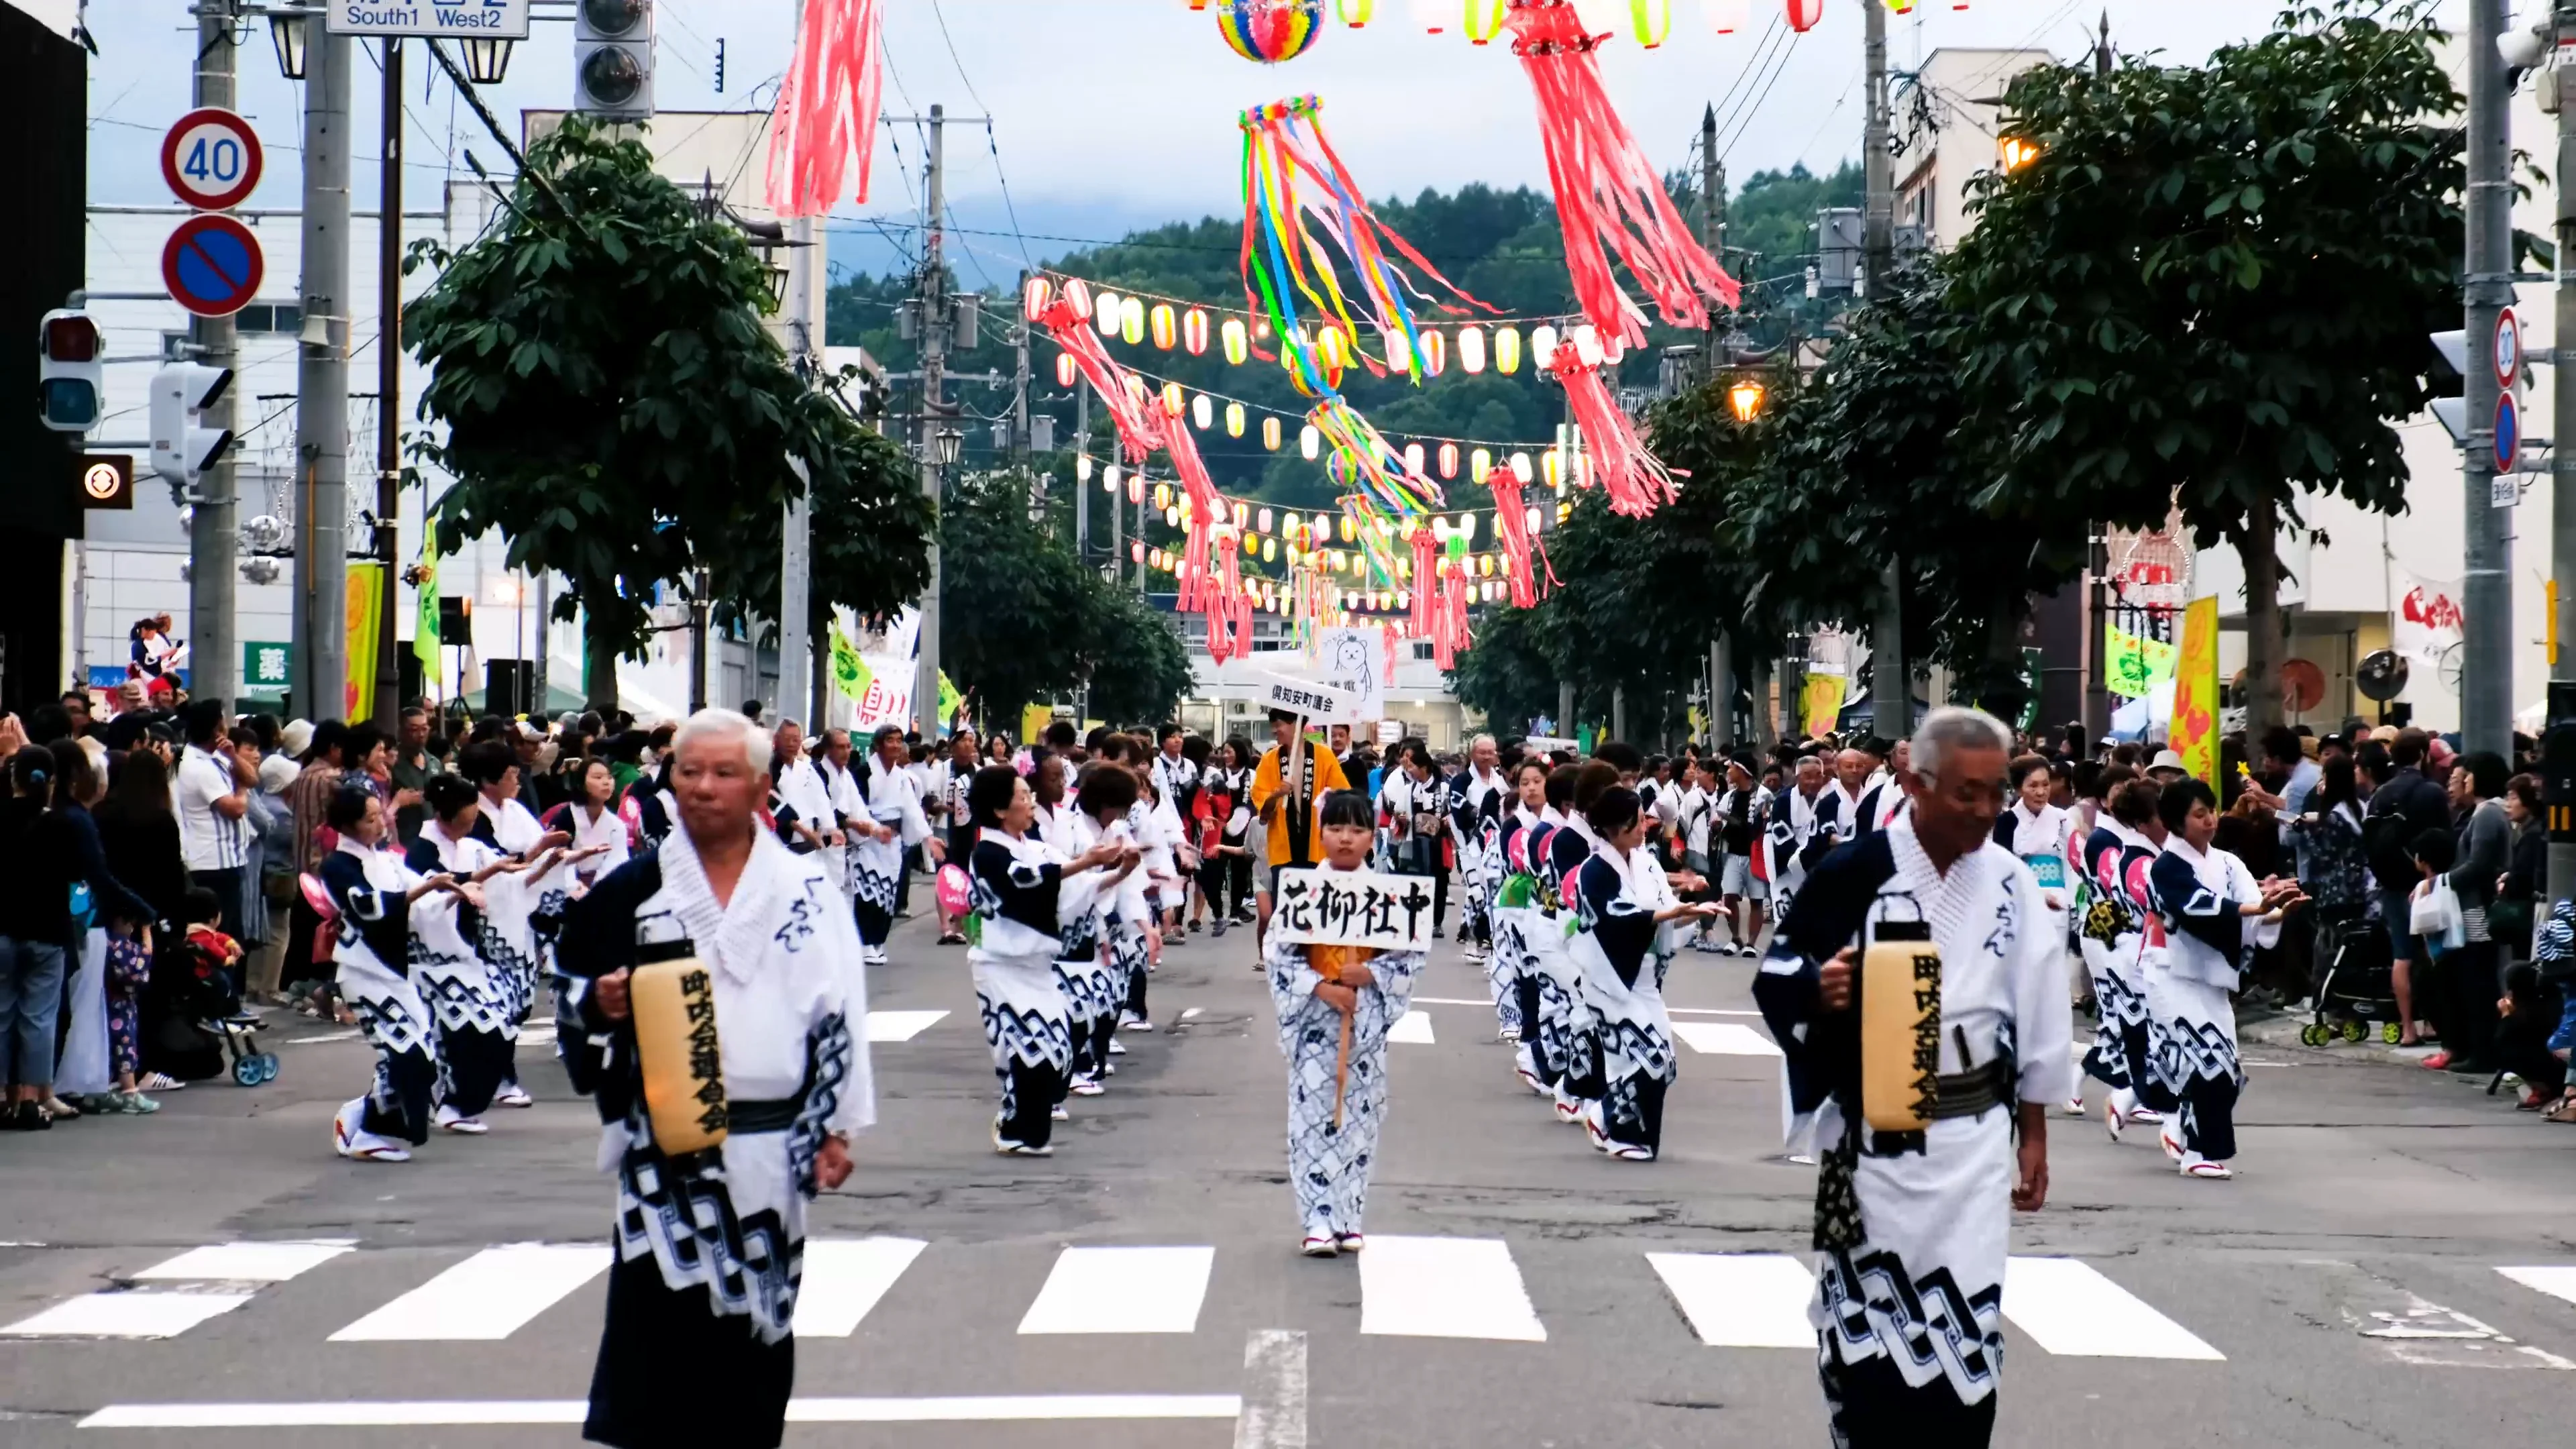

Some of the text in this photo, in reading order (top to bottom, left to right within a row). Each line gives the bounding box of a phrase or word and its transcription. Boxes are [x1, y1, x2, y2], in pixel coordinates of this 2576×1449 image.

[347, 6, 501, 28] South1 West2
[184, 138, 238, 181] 40
[259, 647, 285, 680] 薬
[1272, 684, 1334, 712] 倶知安町議会
[773, 875, 824, 953] くっちゃん
[1279, 879, 1431, 943] 花柳社中
